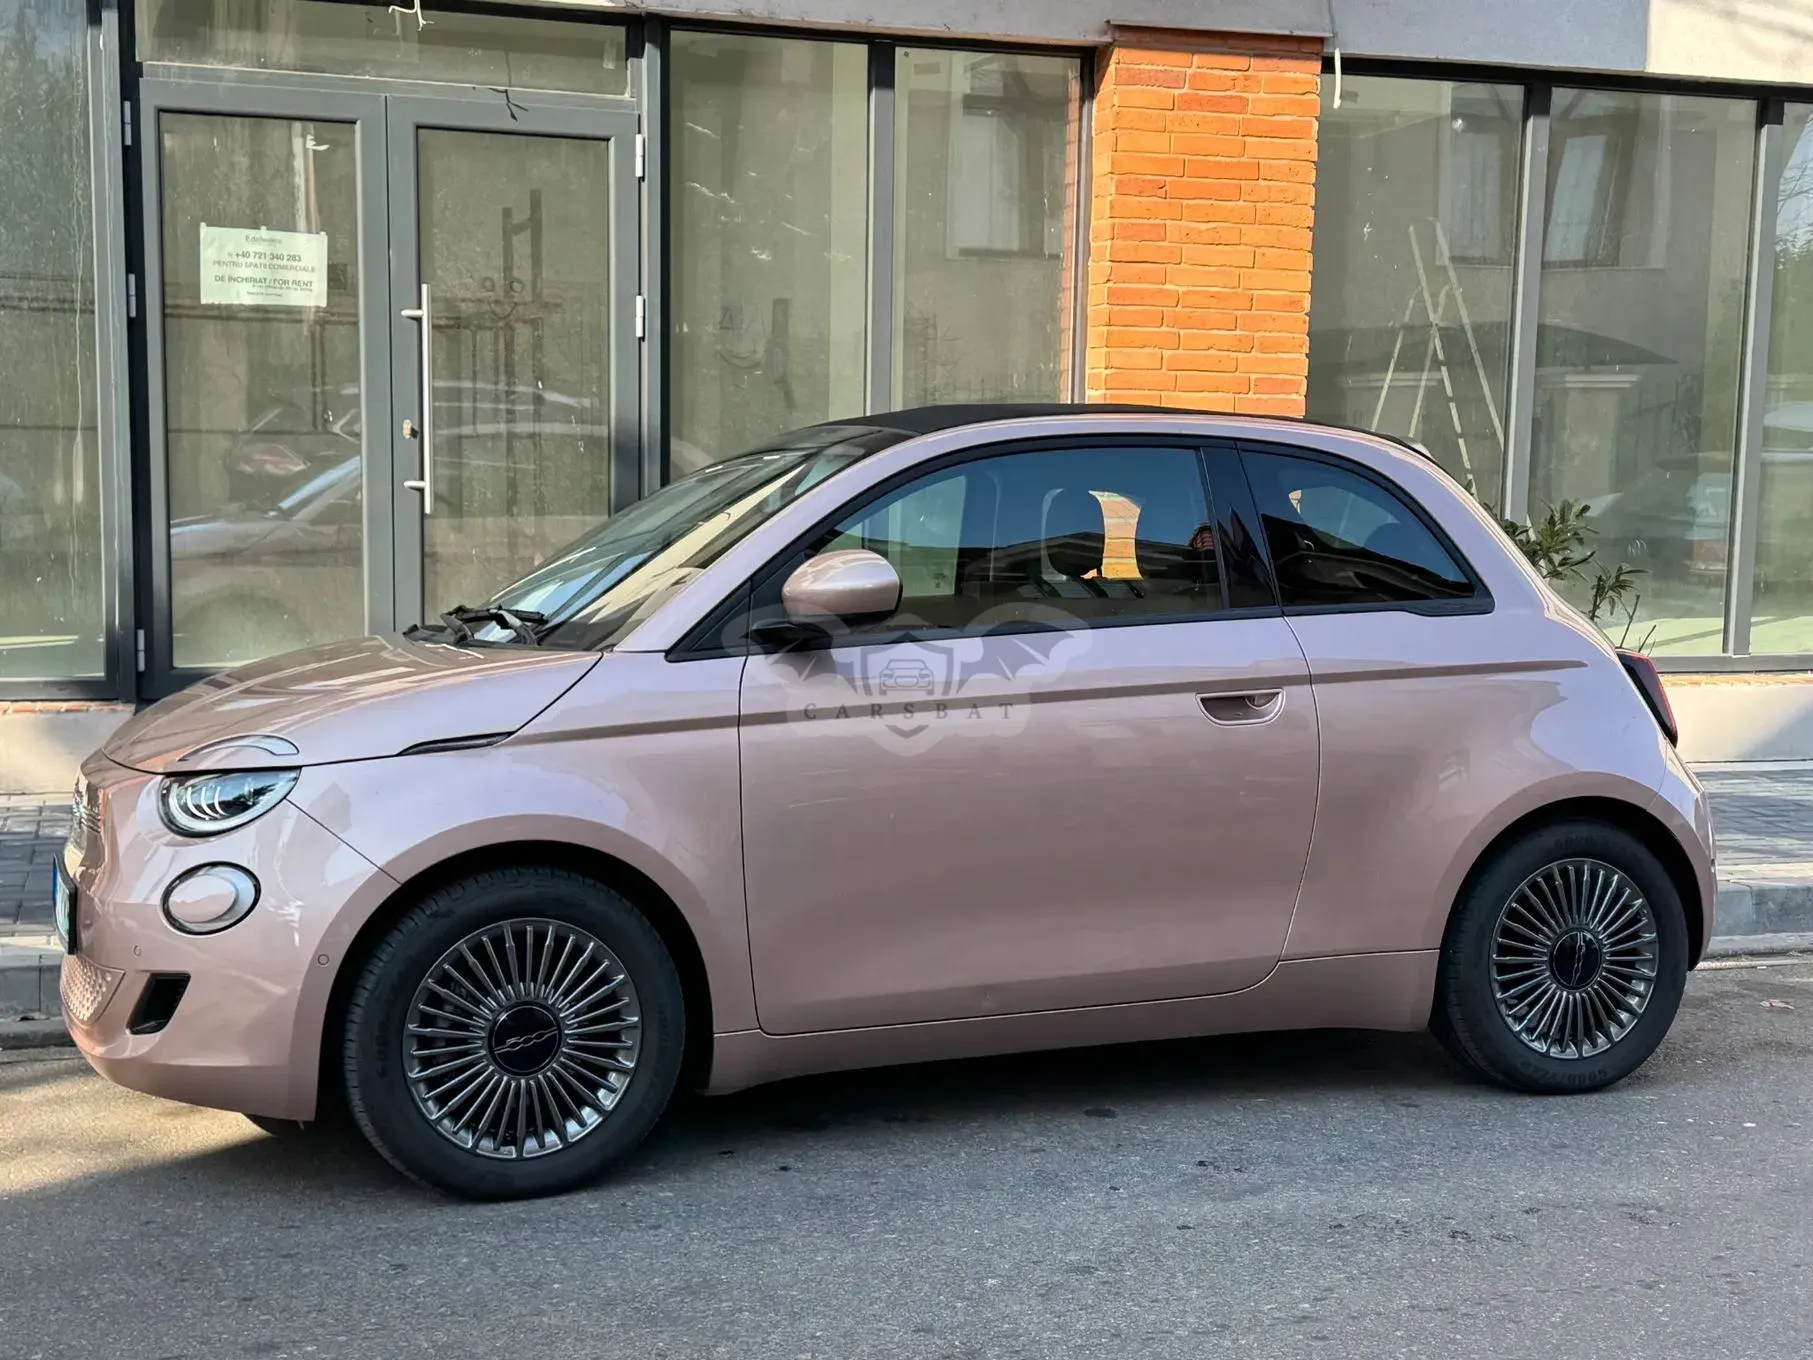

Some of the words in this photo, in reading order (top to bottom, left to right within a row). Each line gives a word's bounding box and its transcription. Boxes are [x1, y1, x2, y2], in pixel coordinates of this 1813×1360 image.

[235, 251, 250, 259] +40
[253, 251, 267, 260] 721
[269, 252, 284, 261] 340
[286, 253, 302, 262] 283
[214, 274, 226, 282] DE
[273, 278, 290, 286] FOR
[291, 280, 314, 288] RENT
